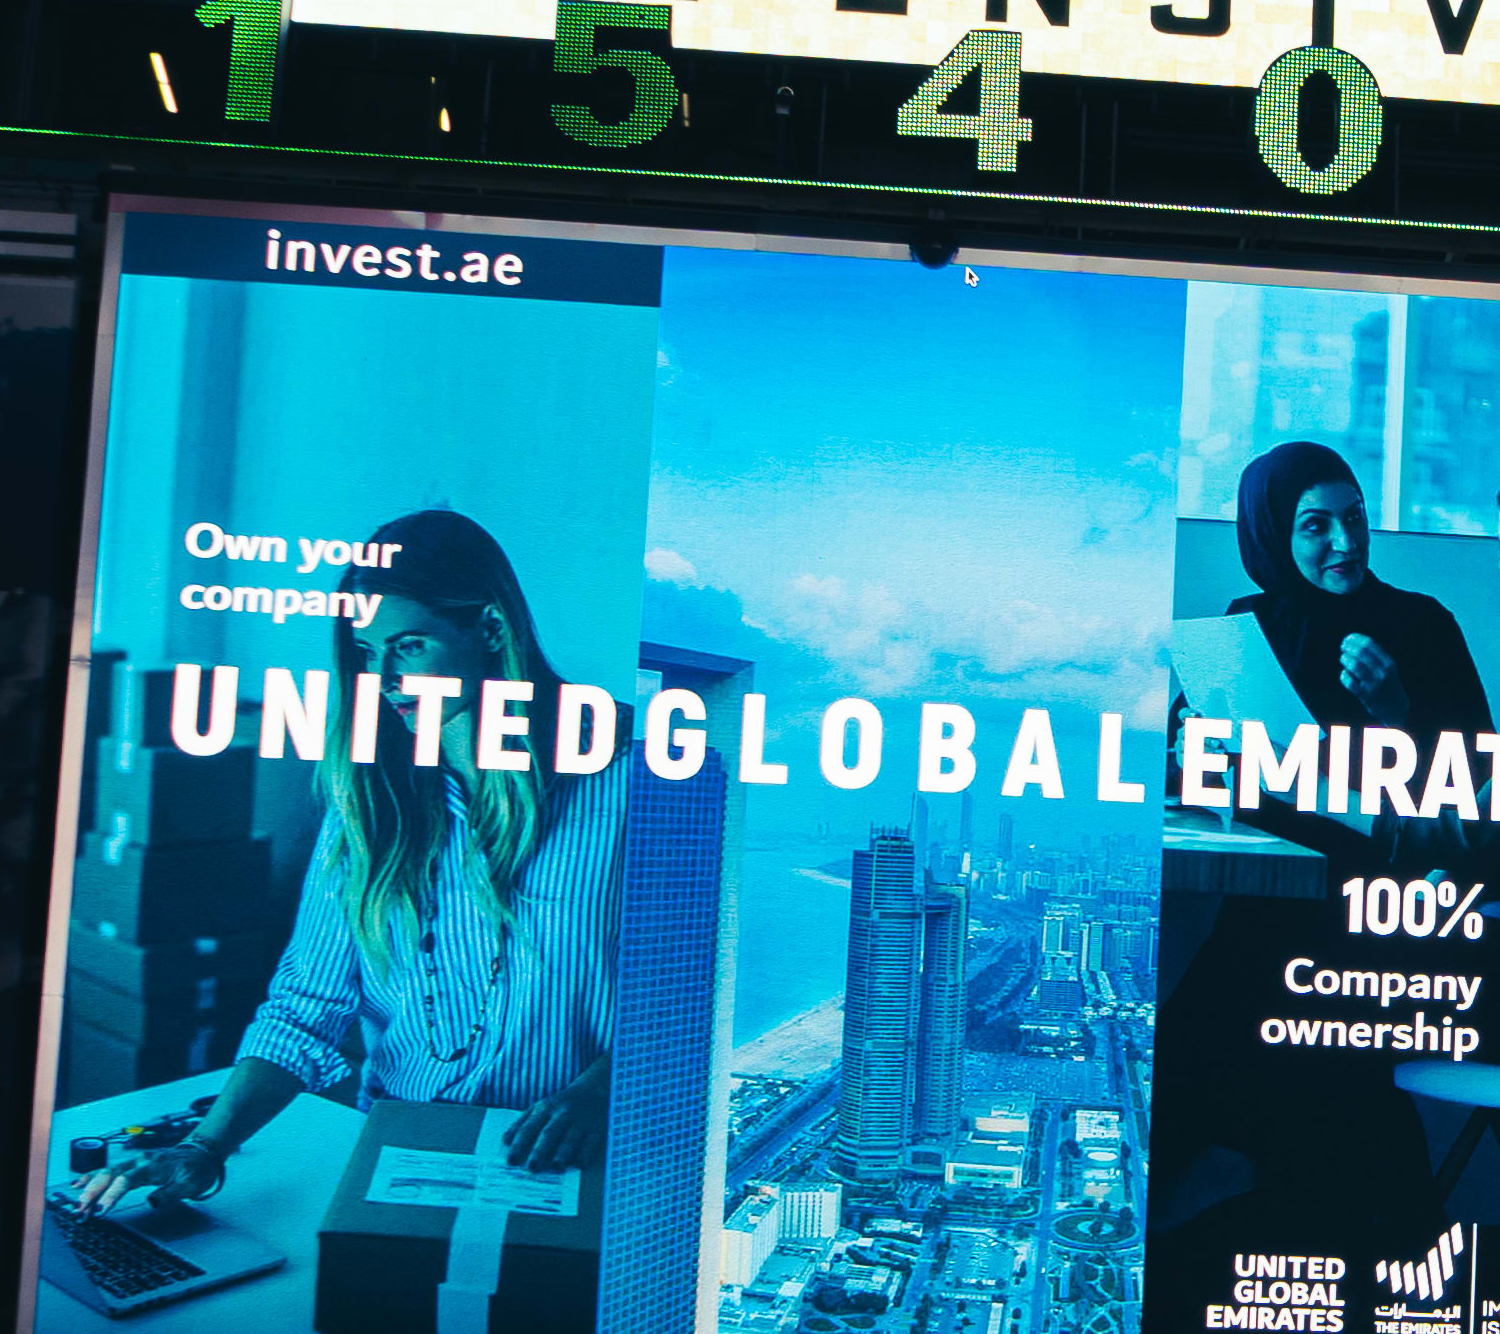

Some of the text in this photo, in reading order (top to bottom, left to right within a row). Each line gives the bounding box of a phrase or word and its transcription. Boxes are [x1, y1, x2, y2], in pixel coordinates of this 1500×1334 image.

[265, 228, 525, 286] invest.ae
[184, 521, 403, 574] Own your
[179, 580, 384, 629] company
[1342, 875, 1485, 941] 100%
[1282, 958, 1482, 1008] Company
[1260, 1012, 1481, 1062] ownership
[1234, 1253, 1346, 1281] UNITED
[1233, 1280, 1345, 1307] GLOBAL
[1206, 1305, 1345, 1334] EMIRATES
[1374, 1321, 1399, 1334] THE
